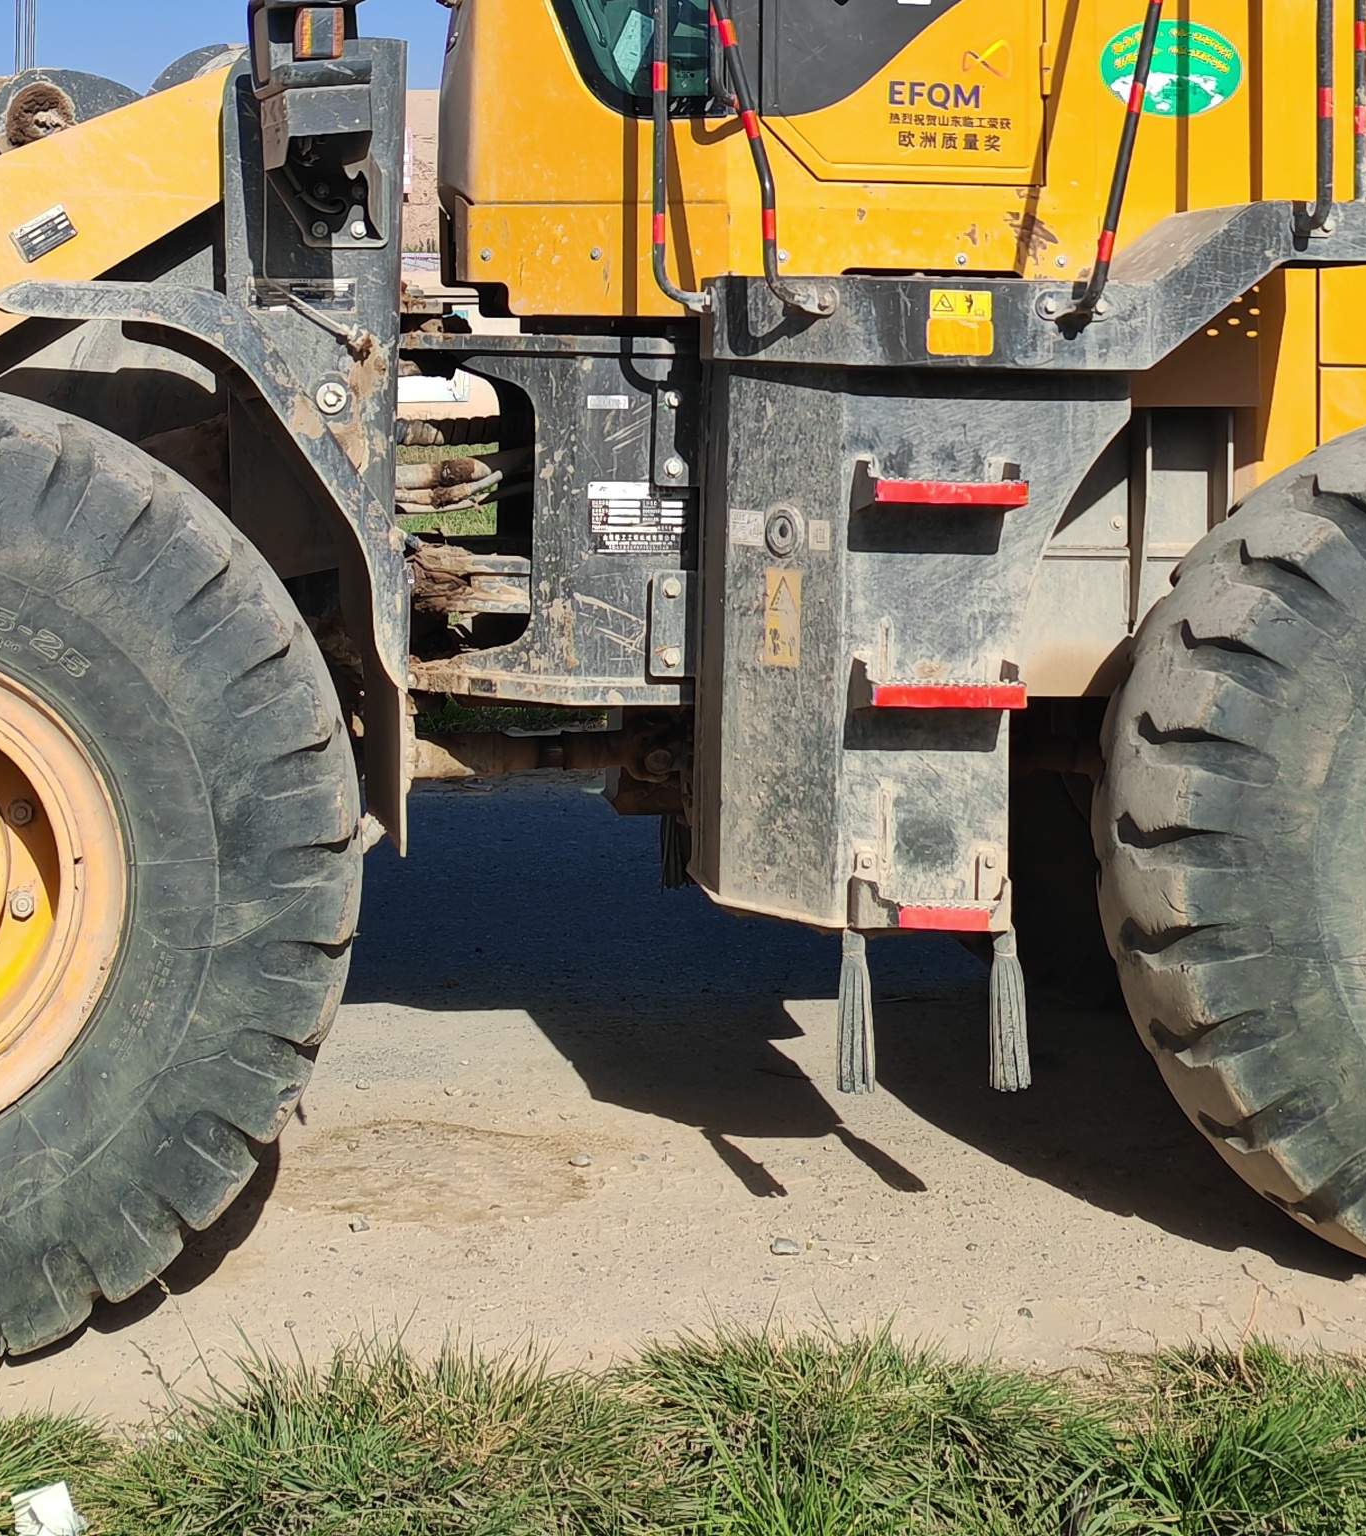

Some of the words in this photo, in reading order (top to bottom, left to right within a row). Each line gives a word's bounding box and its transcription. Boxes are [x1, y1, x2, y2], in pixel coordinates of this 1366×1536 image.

[888, 80, 981, 111] EFQM
[888, 112, 1012, 131] 热烈祝贺山东临工荣获
[898, 131, 1002, 153] 欧洲质量奖
